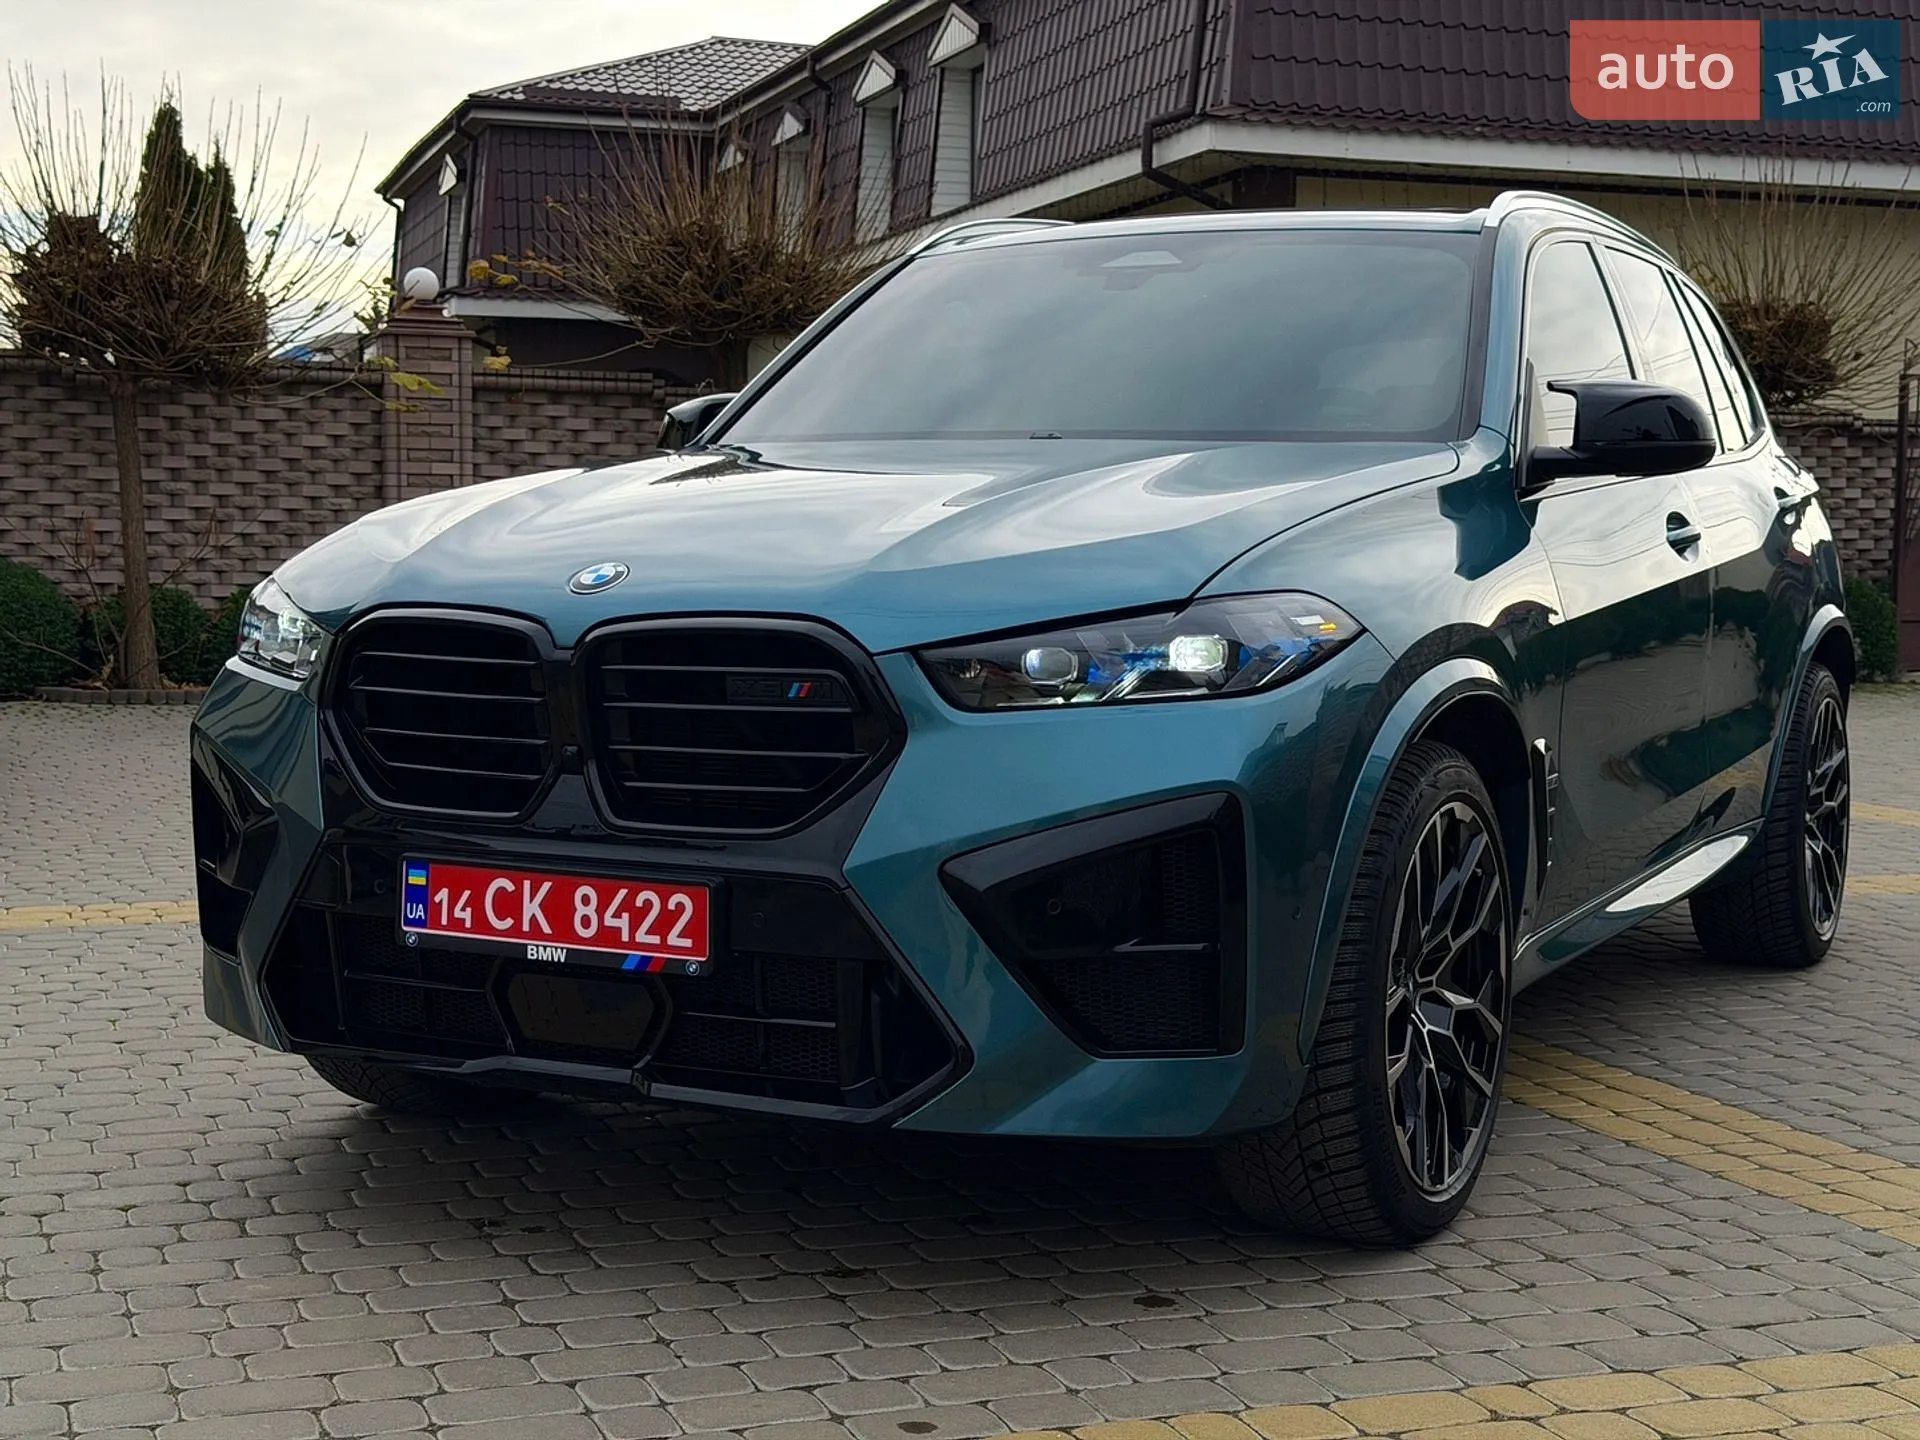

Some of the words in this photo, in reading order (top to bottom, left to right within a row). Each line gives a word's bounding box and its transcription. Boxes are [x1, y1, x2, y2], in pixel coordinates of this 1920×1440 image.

[406, 902, 425, 920] UA
[433, 887, 472, 929] 14
[484, 877, 553, 934] CK
[573, 885, 694, 948] 8422
[527, 945, 567, 963] BMW
